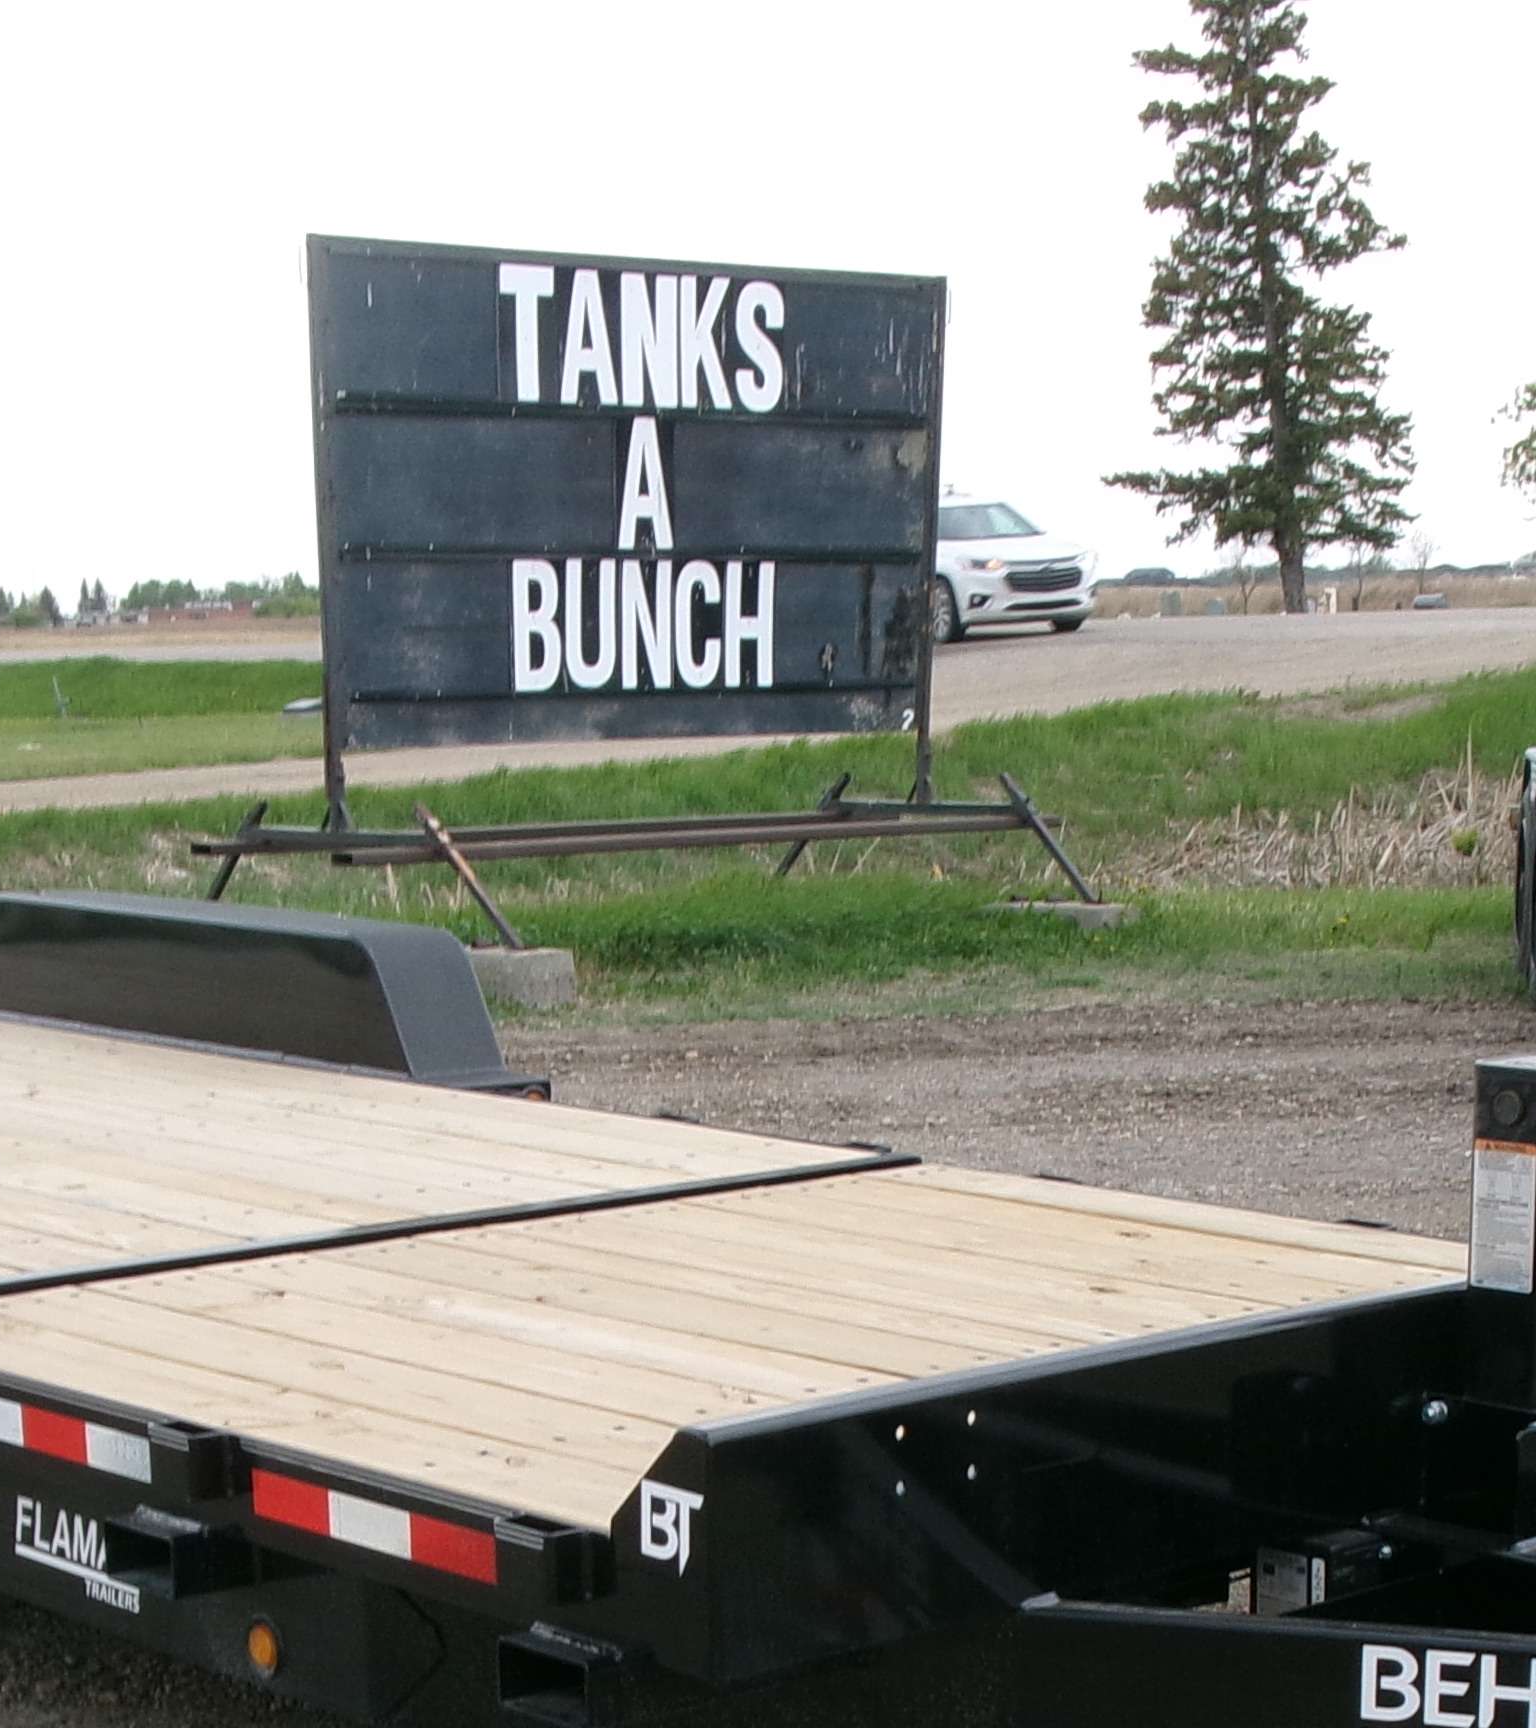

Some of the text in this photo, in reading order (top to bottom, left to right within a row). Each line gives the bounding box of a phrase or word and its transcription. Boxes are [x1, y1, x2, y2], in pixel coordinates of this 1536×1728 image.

[499, 263, 784, 413] TANKS
[618, 415, 673, 549] A
[512, 557, 776, 692] BUNCH
[640, 1478, 704, 1577] BT
[83, 1576, 140, 1614] TRAILERS
